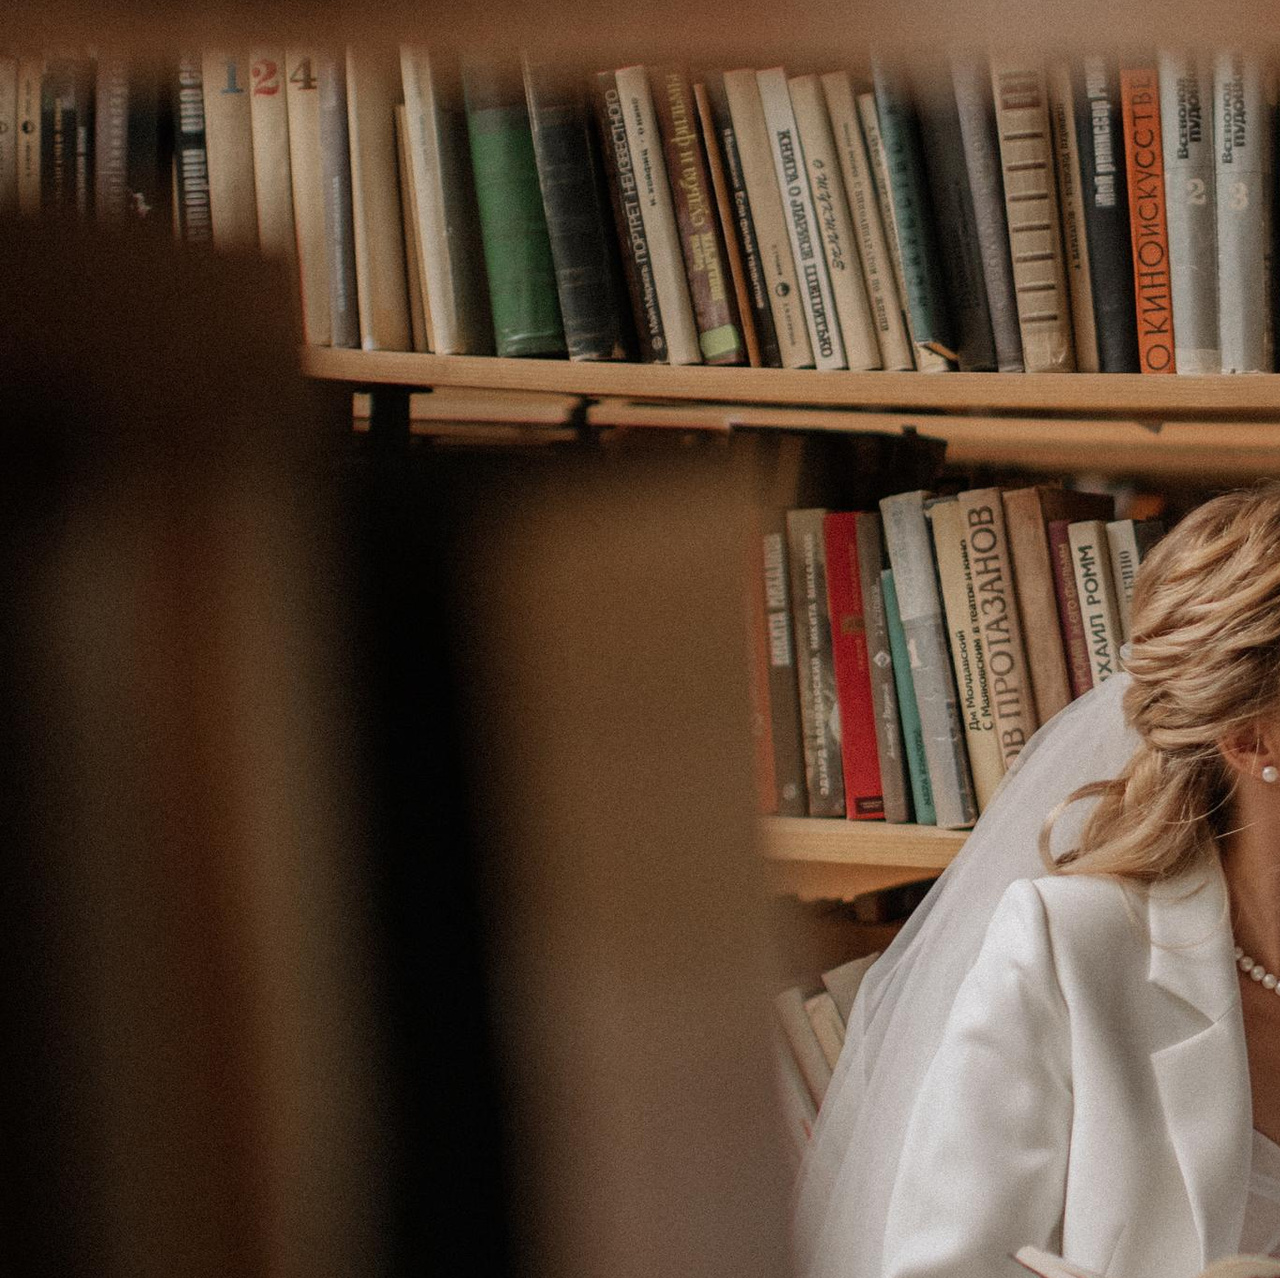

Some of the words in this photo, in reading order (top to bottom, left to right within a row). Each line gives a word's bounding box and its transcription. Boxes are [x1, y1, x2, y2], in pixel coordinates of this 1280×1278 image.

[221, 60, 244, 95] 1
[251, 58, 281, 96] 2
[289, 57, 317, 92] 4
[605, 89, 635, 195] НЕИЗВЕСТНОГО
[776, 129, 798, 184] КНИГА
[678, 166, 708, 226] судьба
[787, 185, 802, 197] О
[1126, 73, 1170, 334] КИНОИСКУССТВЕ
[1187, 178, 1207, 205] 2
[1228, 182, 1249, 211] 3
[626, 200, 647, 262] ПОРТРЕТ
[790, 198, 814, 259] ЛАРИСЕ
[804, 263, 834, 357] ШЕПИТЬКО
[1144, 343, 1172, 370] О
[959, 539, 970, 574] кино
[1079, 543, 1099, 605] РОММ
[966, 583, 979, 623] театре
[967, 505, 1020, 717] ПРОТАЗАНОВ
[955, 628, 975, 707] Молдавский
[973, 638, 990, 718] Маяковским
[983, 722, 993, 731] С
